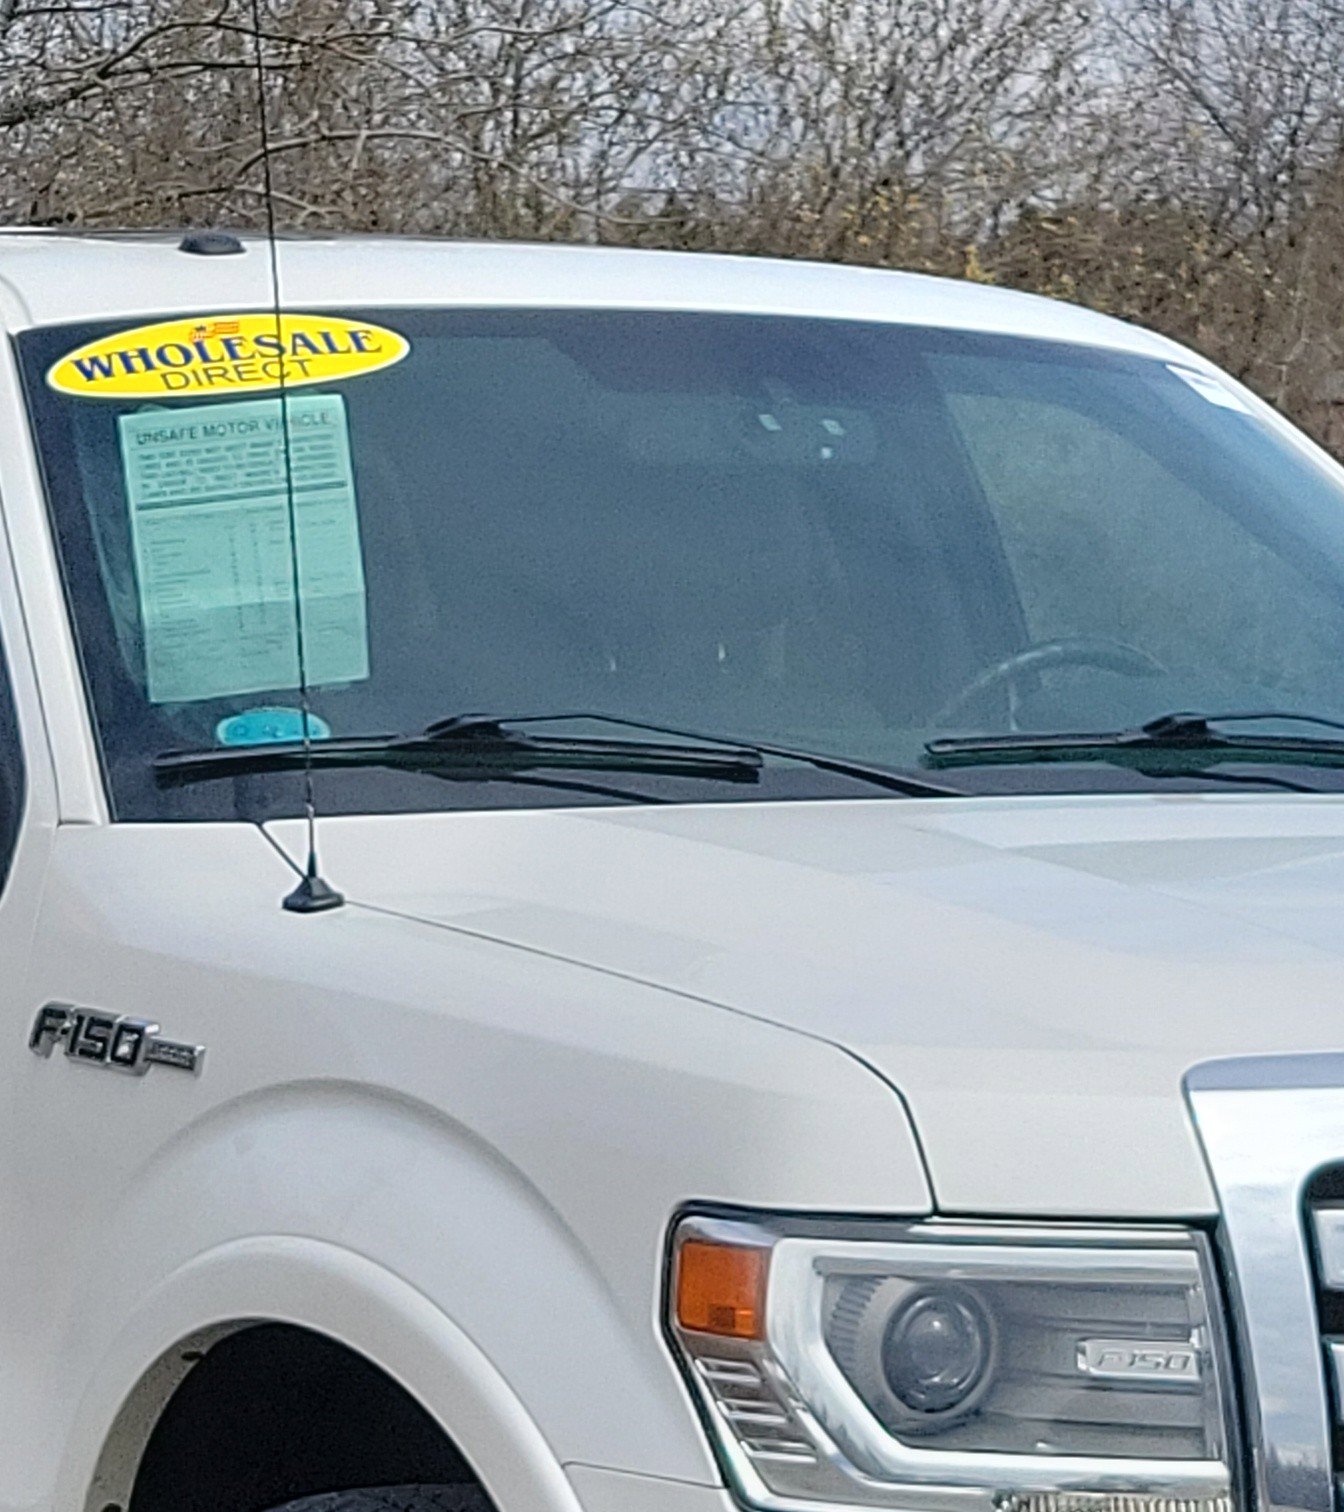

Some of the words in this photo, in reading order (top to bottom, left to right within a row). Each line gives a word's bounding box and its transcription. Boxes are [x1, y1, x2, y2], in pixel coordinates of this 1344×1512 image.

[71, 329, 383, 383] WHOLESALE
[160, 358, 313, 391] DIRECT
[136, 425, 197, 446] UNSAFE
[203, 419, 261, 438] MOTOR
